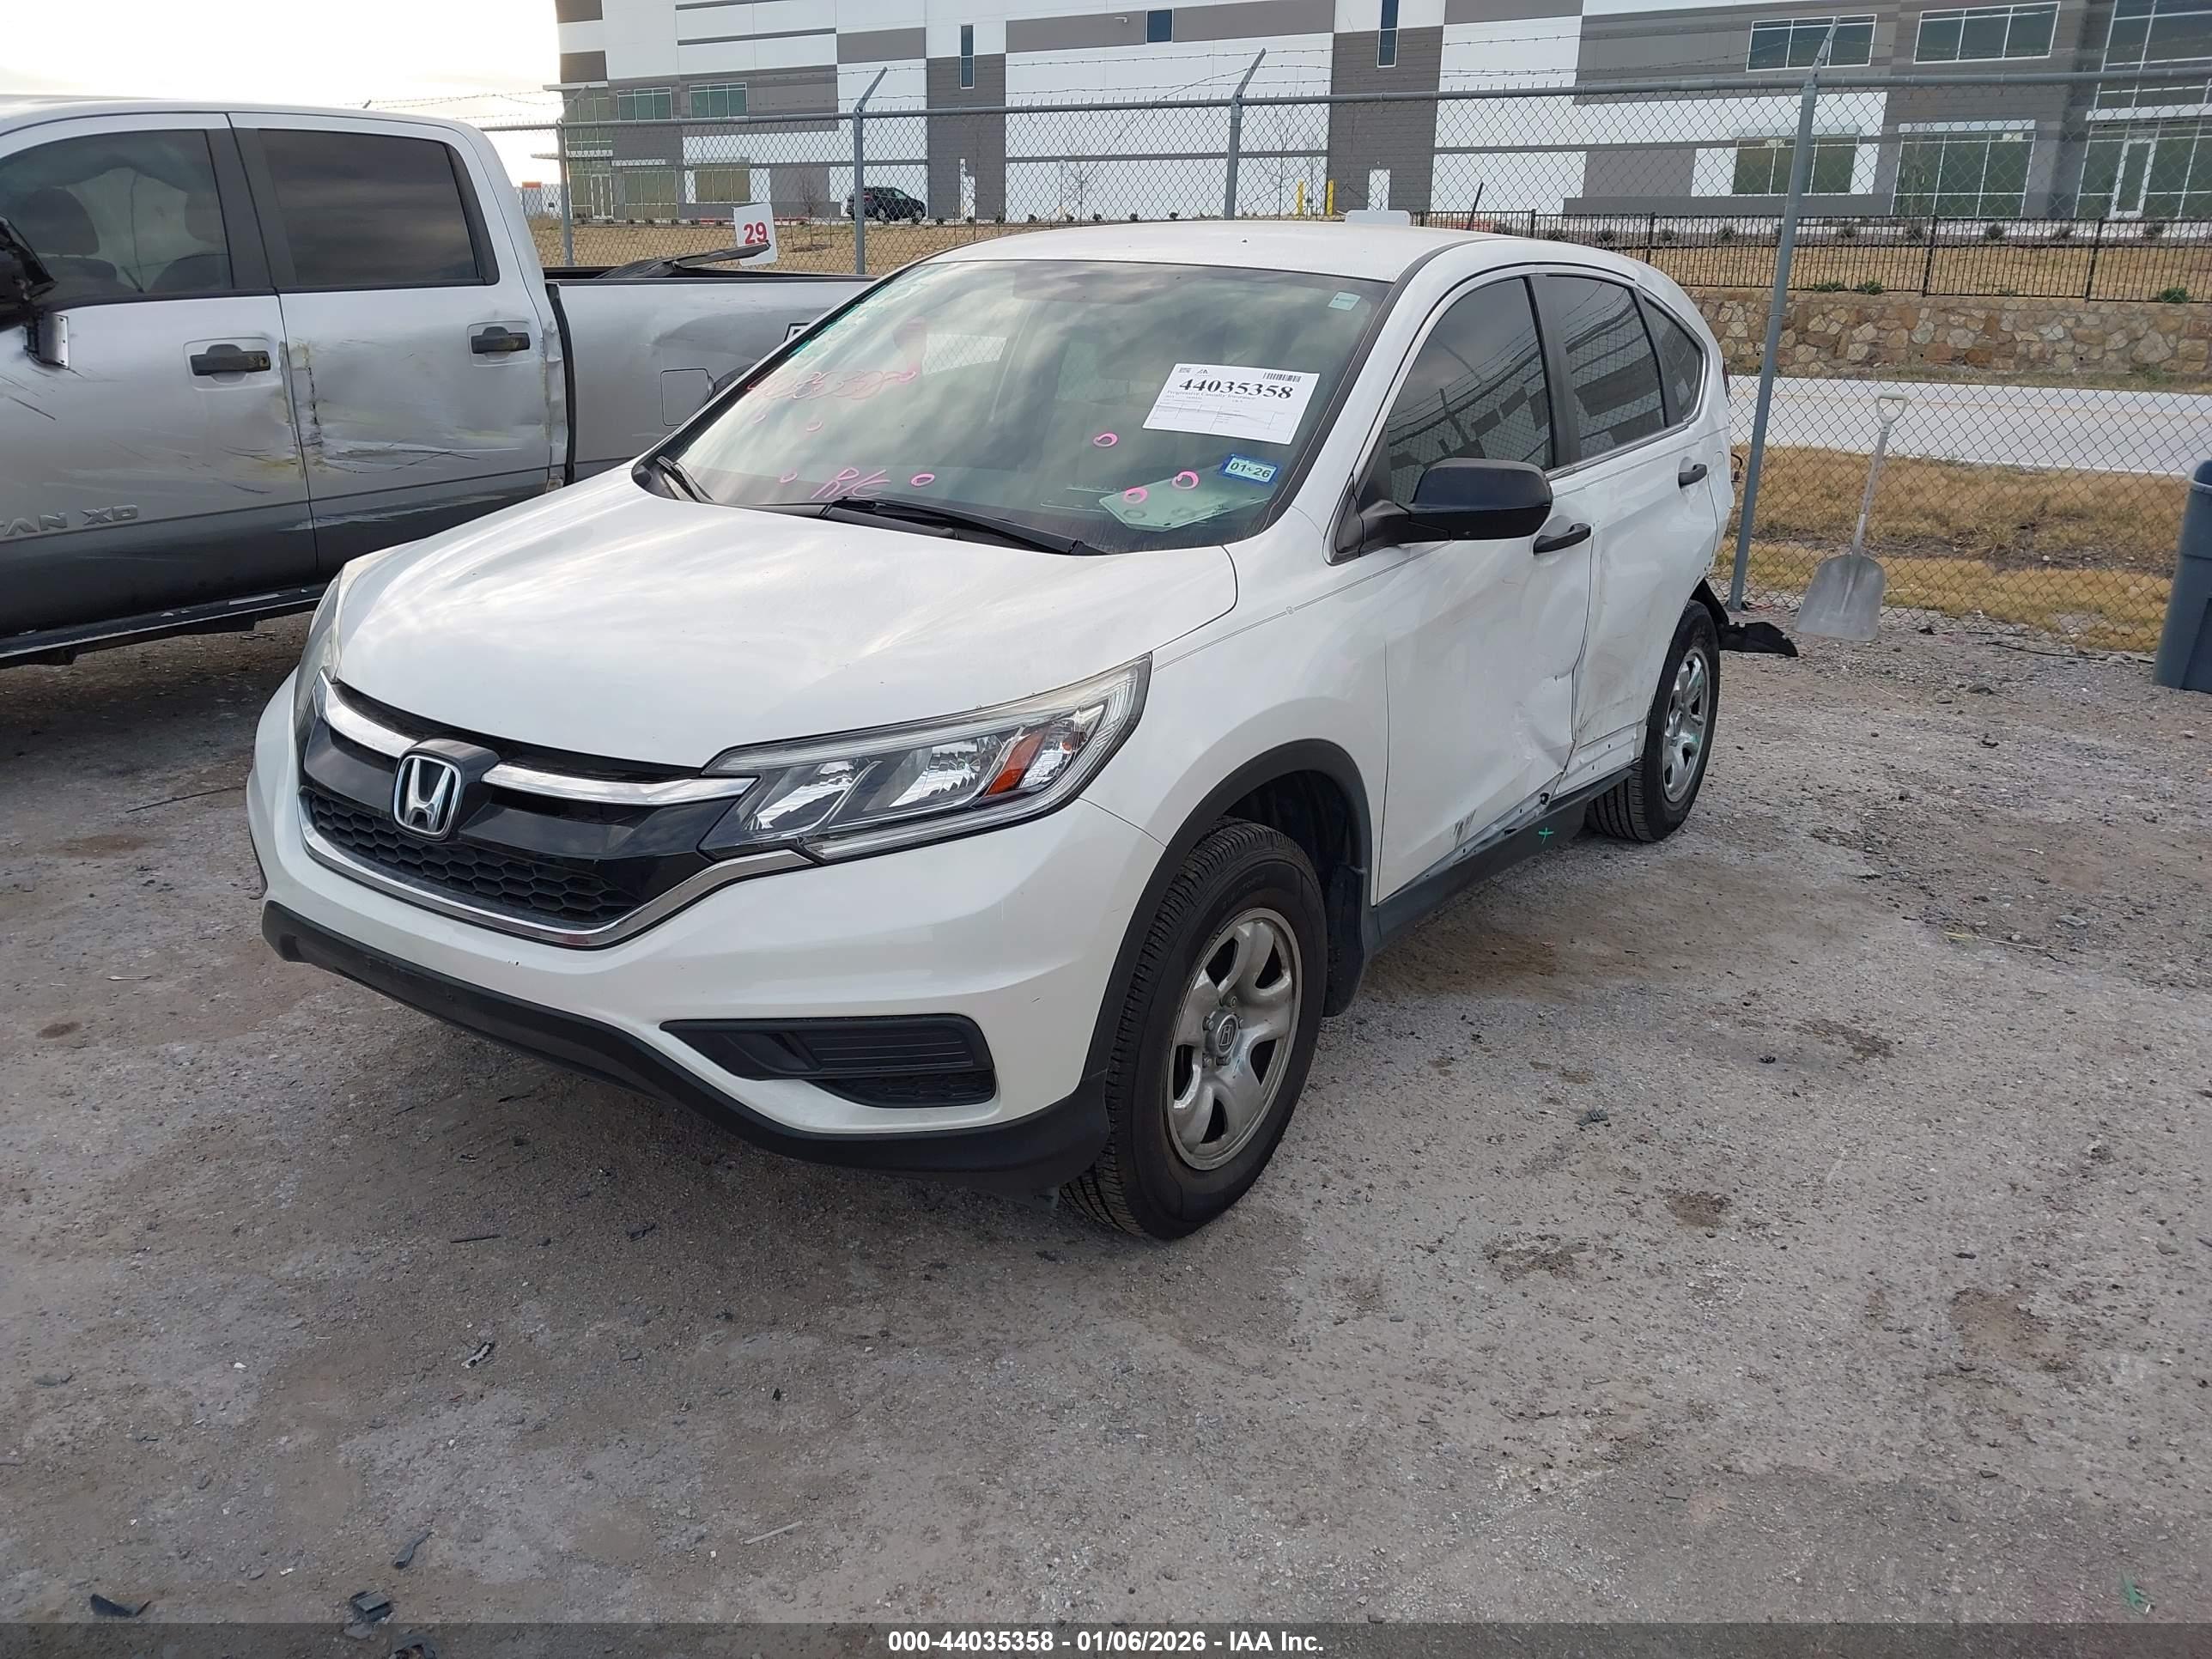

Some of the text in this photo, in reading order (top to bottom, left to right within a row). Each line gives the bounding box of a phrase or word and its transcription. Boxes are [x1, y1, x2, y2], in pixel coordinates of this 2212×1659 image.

[743, 221, 768, 245] 29
[1178, 379, 1294, 400] 44035358
[0, 504, 138, 537] AN XD
